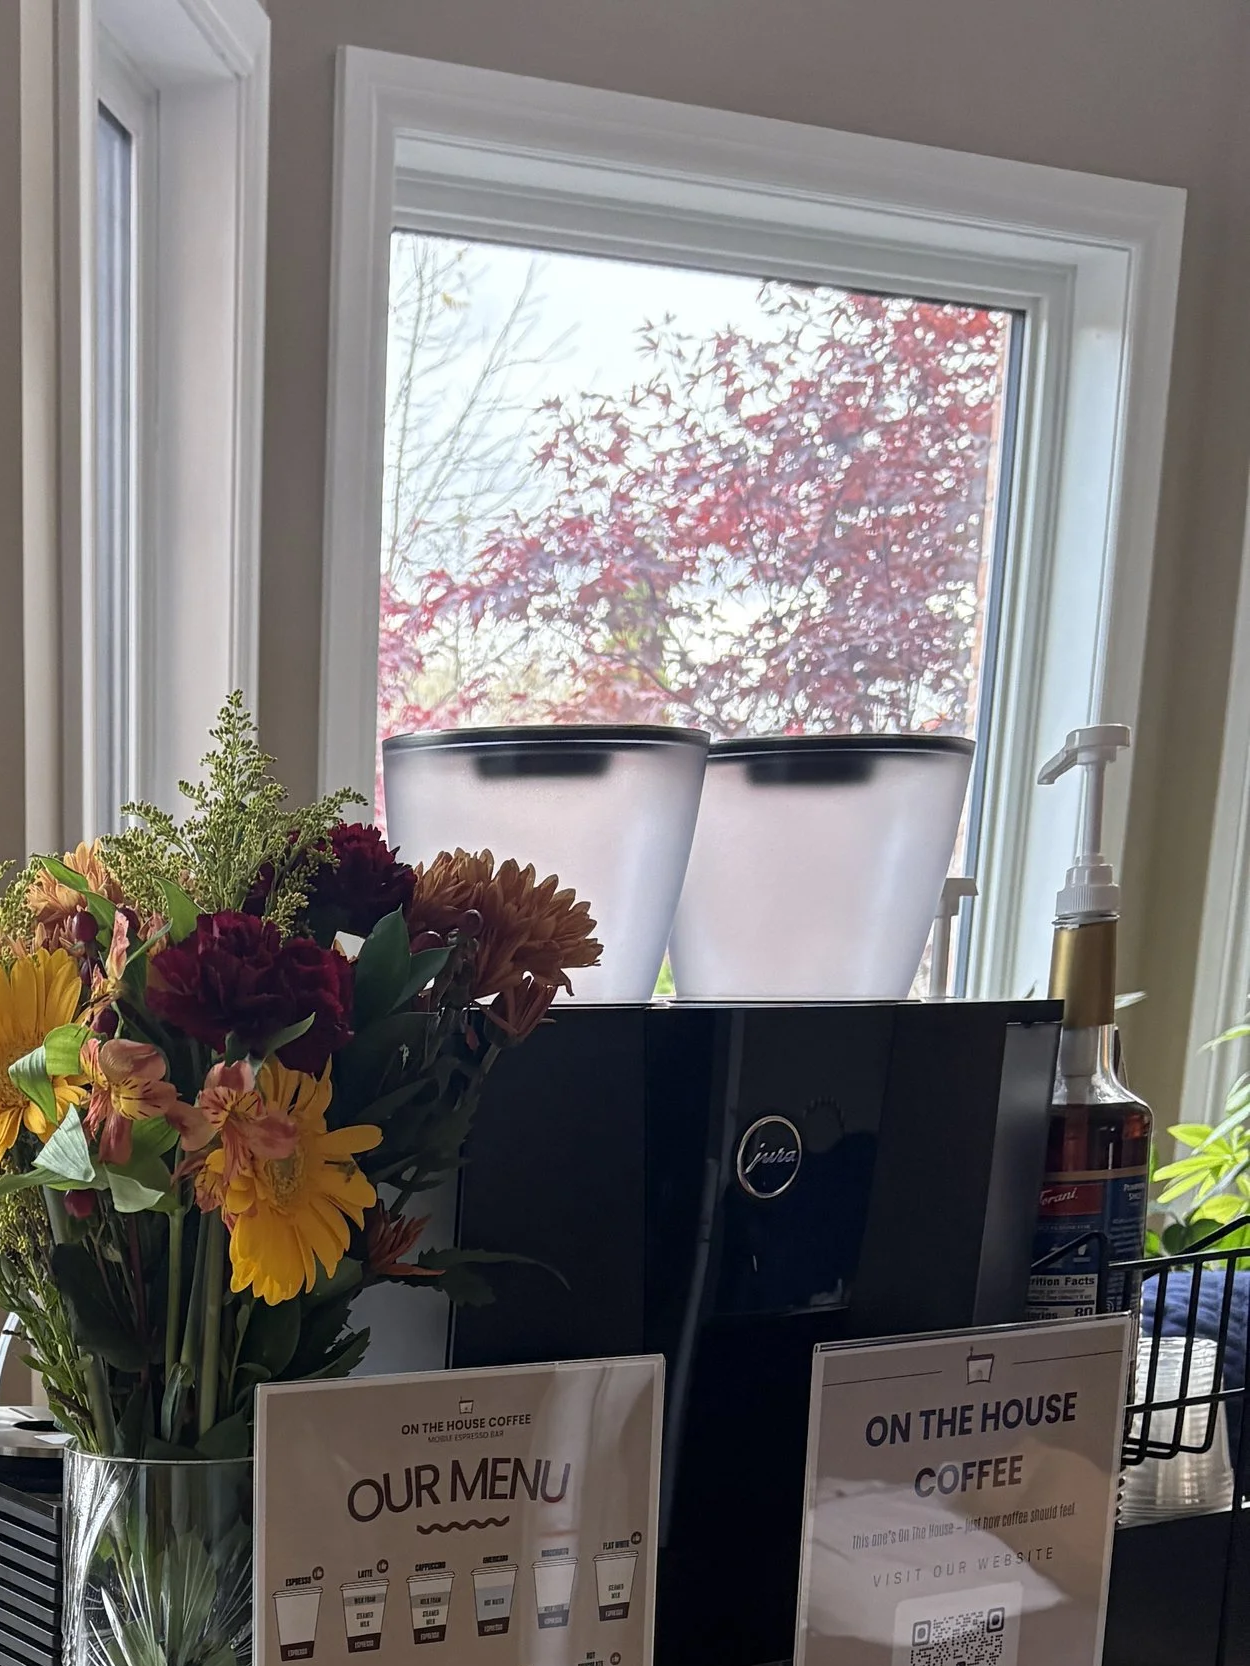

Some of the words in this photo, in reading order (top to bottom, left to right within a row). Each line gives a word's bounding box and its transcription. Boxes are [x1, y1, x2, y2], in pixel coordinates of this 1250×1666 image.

[744, 1142, 797, 1174] jura
[1064, 1276, 1095, 1286] Facts
[401, 1424, 419, 1435] ON
[422, 1421, 444, 1434] THE
[446, 1418, 486, 1432] HOUSE
[488, 1414, 531, 1428] COFFEE
[865, 1411, 911, 1447] ON
[919, 1404, 974, 1440] THE
[980, 1391, 1078, 1432] HOUSE
[347, 1463, 441, 1522] OUR
[450, 1457, 571, 1503] MENU
[914, 1455, 1023, 1498] COFFEE
[852, 1534, 870, 1550] This
[871, 1530, 897, 1546] one's
[898, 1528, 910, 1543] On
[912, 1525, 926, 1540] The
[929, 1522, 954, 1538] House
[964, 1517, 981, 1534] just
[982, 1514, 1001, 1530] how
[1002, 1510, 1028, 1527] coffee
[1030, 1505, 1057, 1523] should
[357, 1569, 373, 1579] LATTE
[873, 1567, 922, 1588] VISIT
[933, 1561, 967, 1578] OUR
[978, 1547, 1054, 1570] WEBSITE
